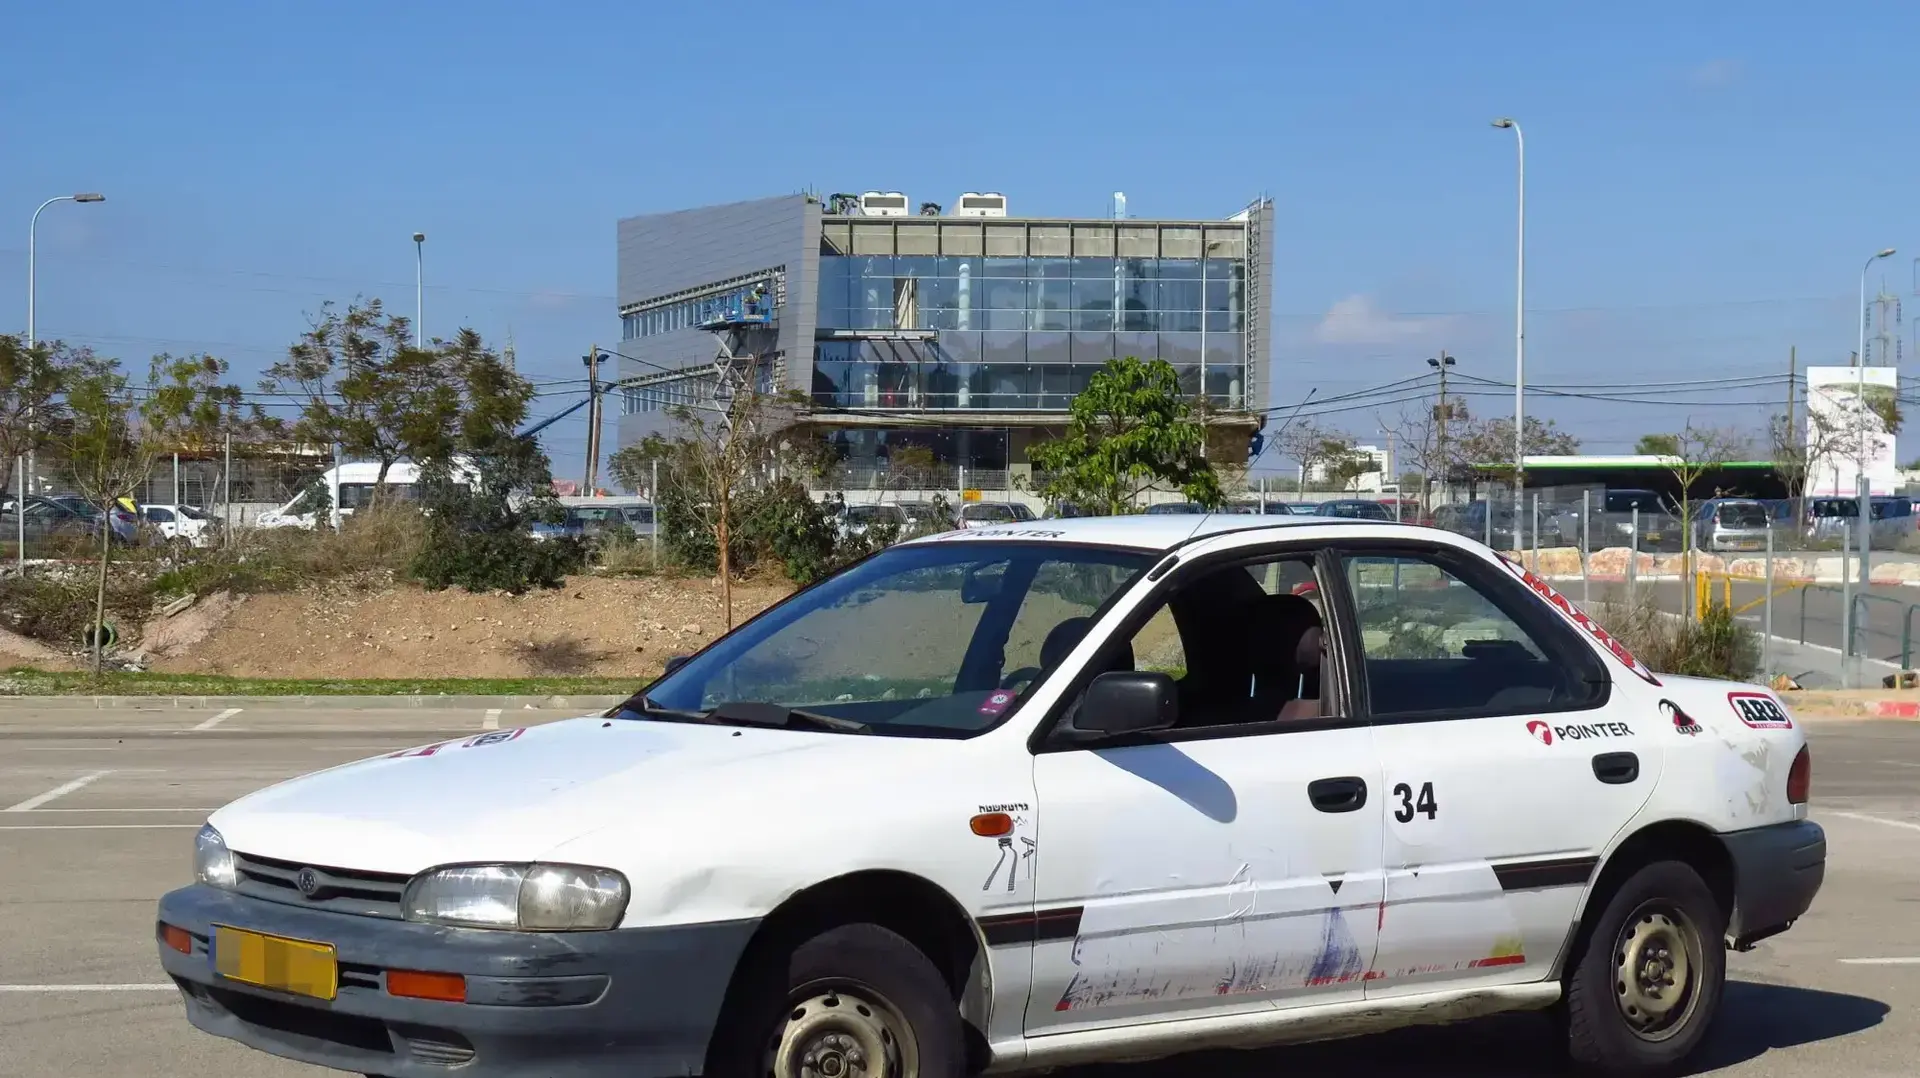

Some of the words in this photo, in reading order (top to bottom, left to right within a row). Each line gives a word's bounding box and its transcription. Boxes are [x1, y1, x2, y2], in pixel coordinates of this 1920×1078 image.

[1523, 572, 1635, 668] MAXXIS
[1736, 699, 1787, 721] ARB
[1554, 722, 1635, 741] POINTER
[1393, 781, 1438, 823] 34
